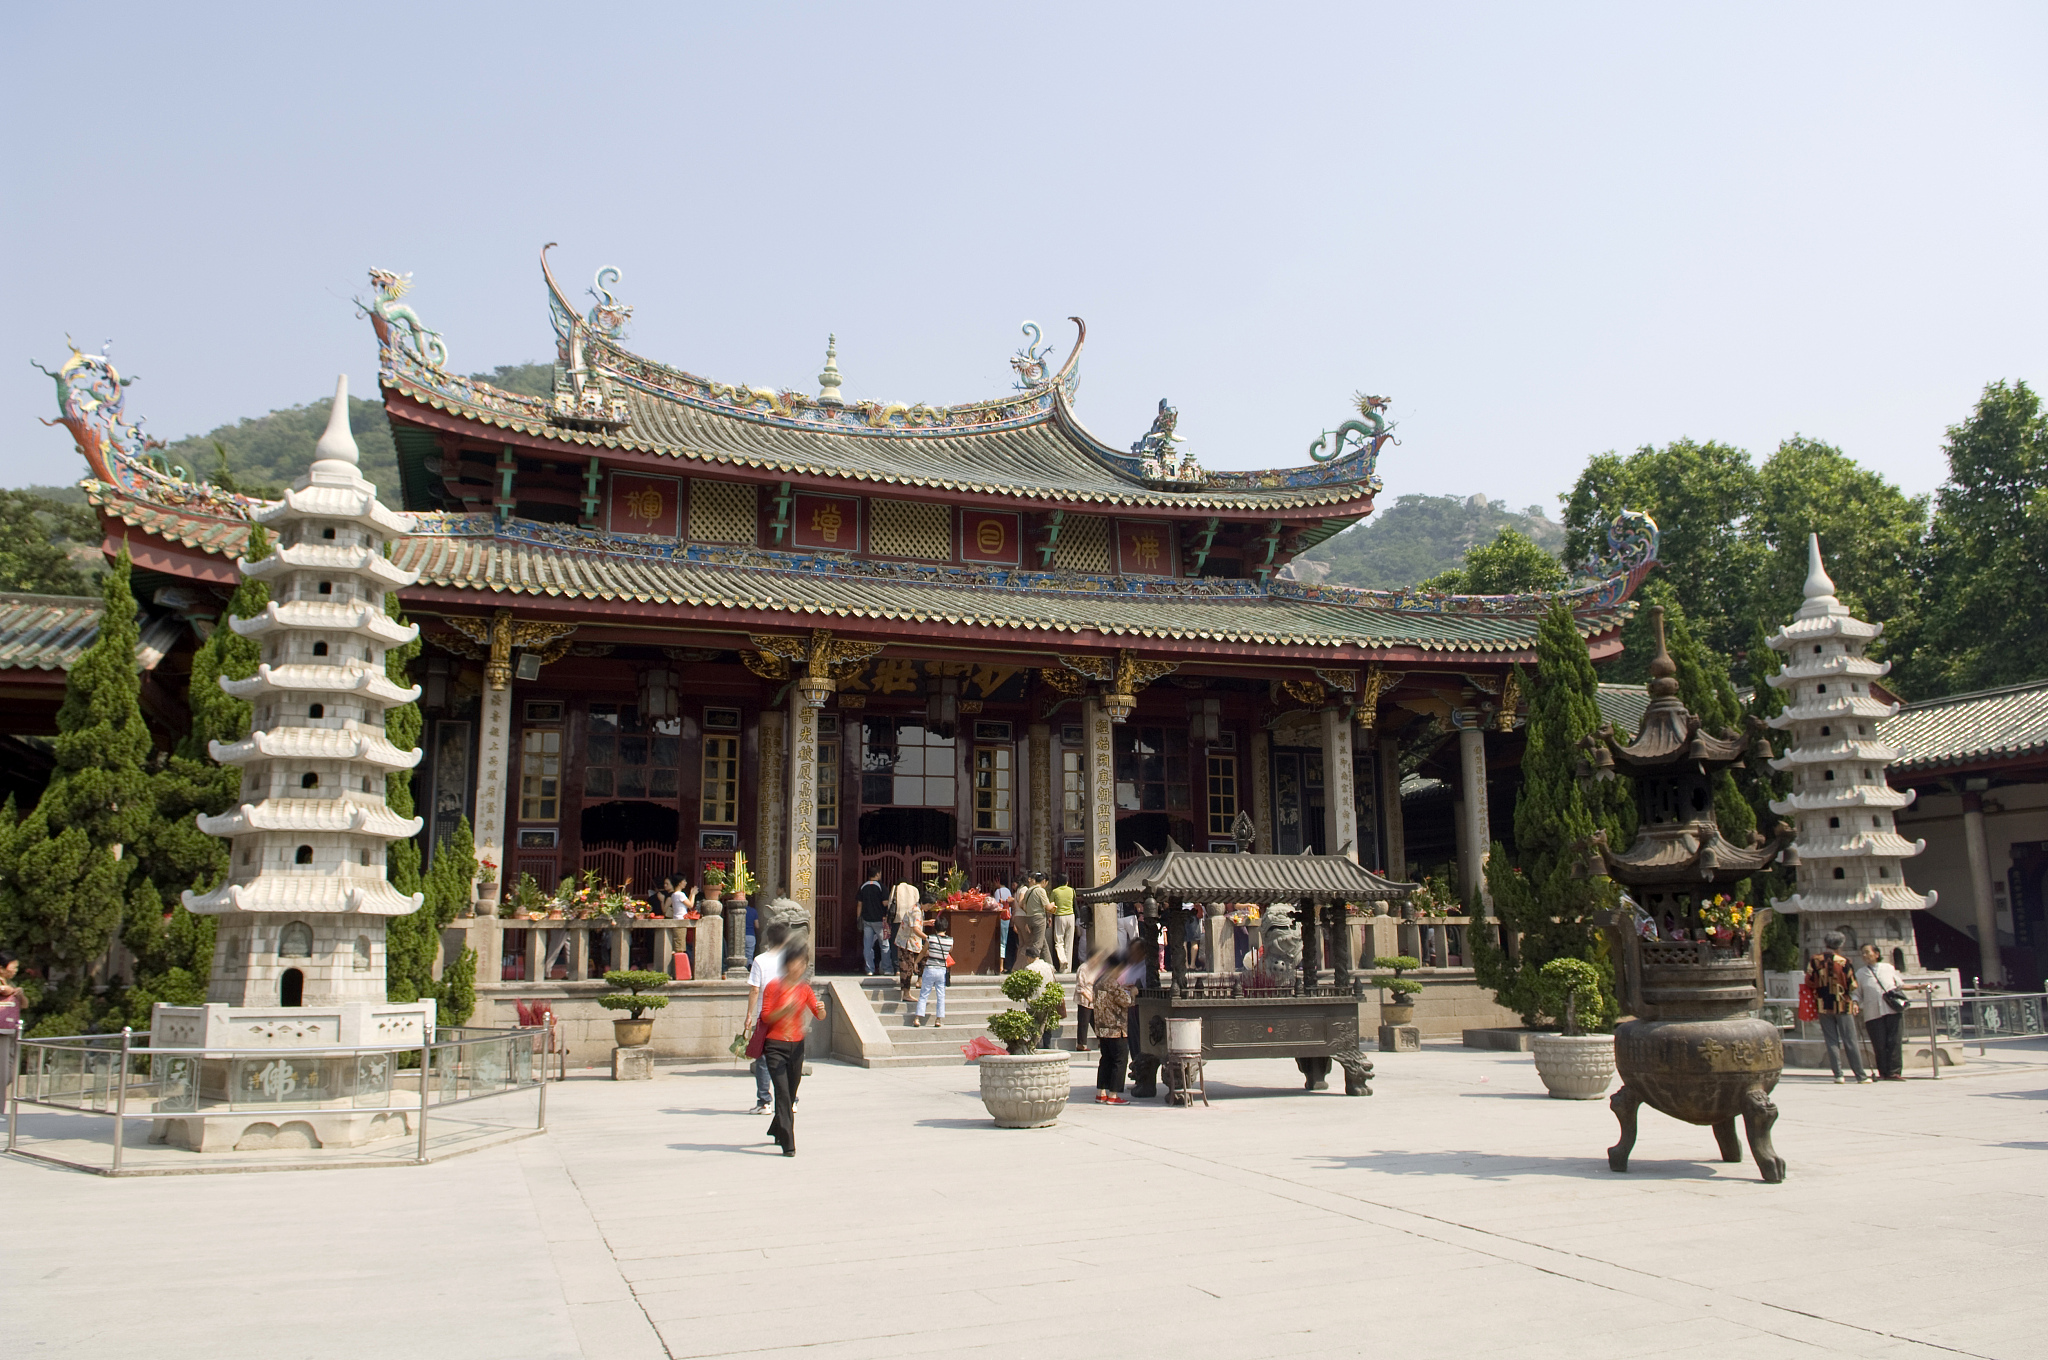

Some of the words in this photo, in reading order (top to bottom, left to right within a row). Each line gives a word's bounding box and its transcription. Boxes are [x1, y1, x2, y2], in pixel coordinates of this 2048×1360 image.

[811, 503, 842, 543] 增
[1132, 530, 1160, 569] 佛
[1224, 1021, 1314, 1041] 南普陀寺
[259, 1059, 296, 1103] 佛
